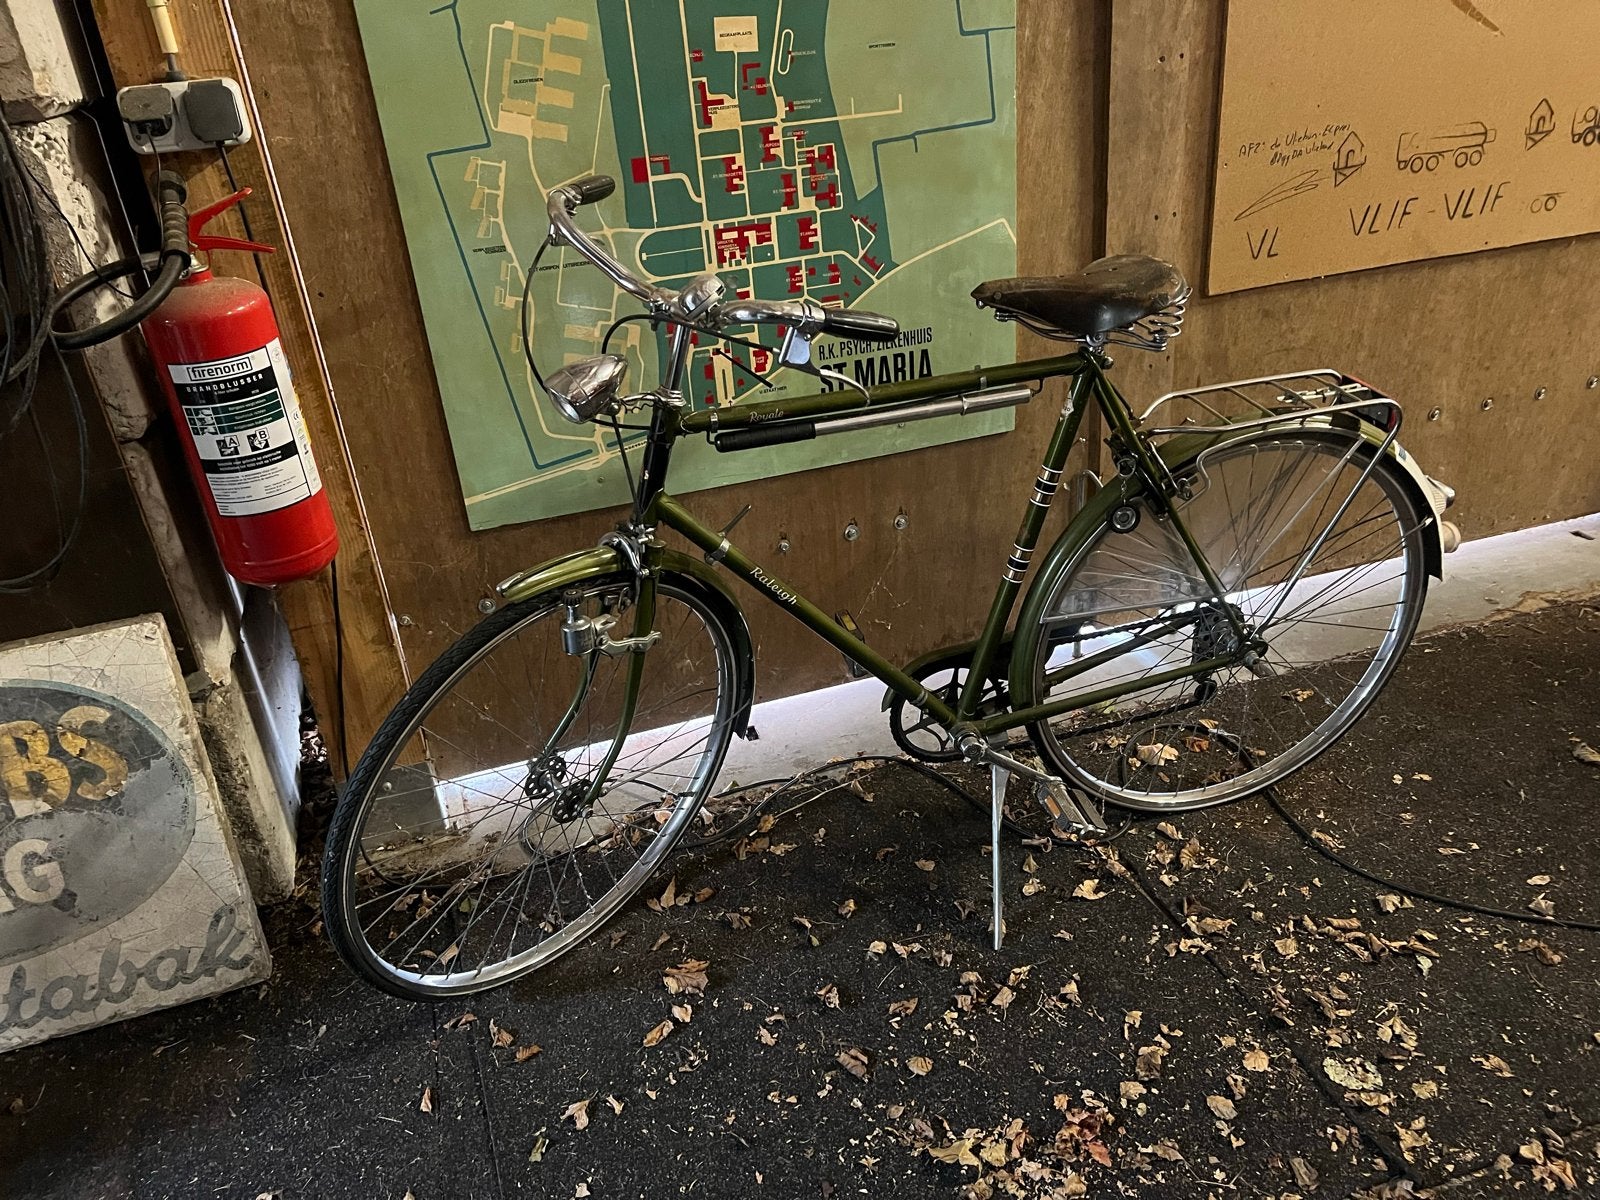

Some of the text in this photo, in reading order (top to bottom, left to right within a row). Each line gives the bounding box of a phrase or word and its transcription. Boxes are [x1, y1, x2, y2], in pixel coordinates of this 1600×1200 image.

[1350, 197, 1419, 237] VLIF
[1444, 181, 1511, 221] VLIF
[1246, 227, 1279, 260] VL
[818, 342, 839, 361] R.K.
[840, 339, 875, 358] PSYCH.
[191, 360, 250, 379] firenorm
[854, 348, 933, 387] MARIA
[186, 373, 264, 393] BRANDBLUSSER
[750, 408, 784, 423] Royale
[228, 437, 238, 447] A
[258, 430, 268, 441] B
[750, 566, 798, 606] Raleigh
